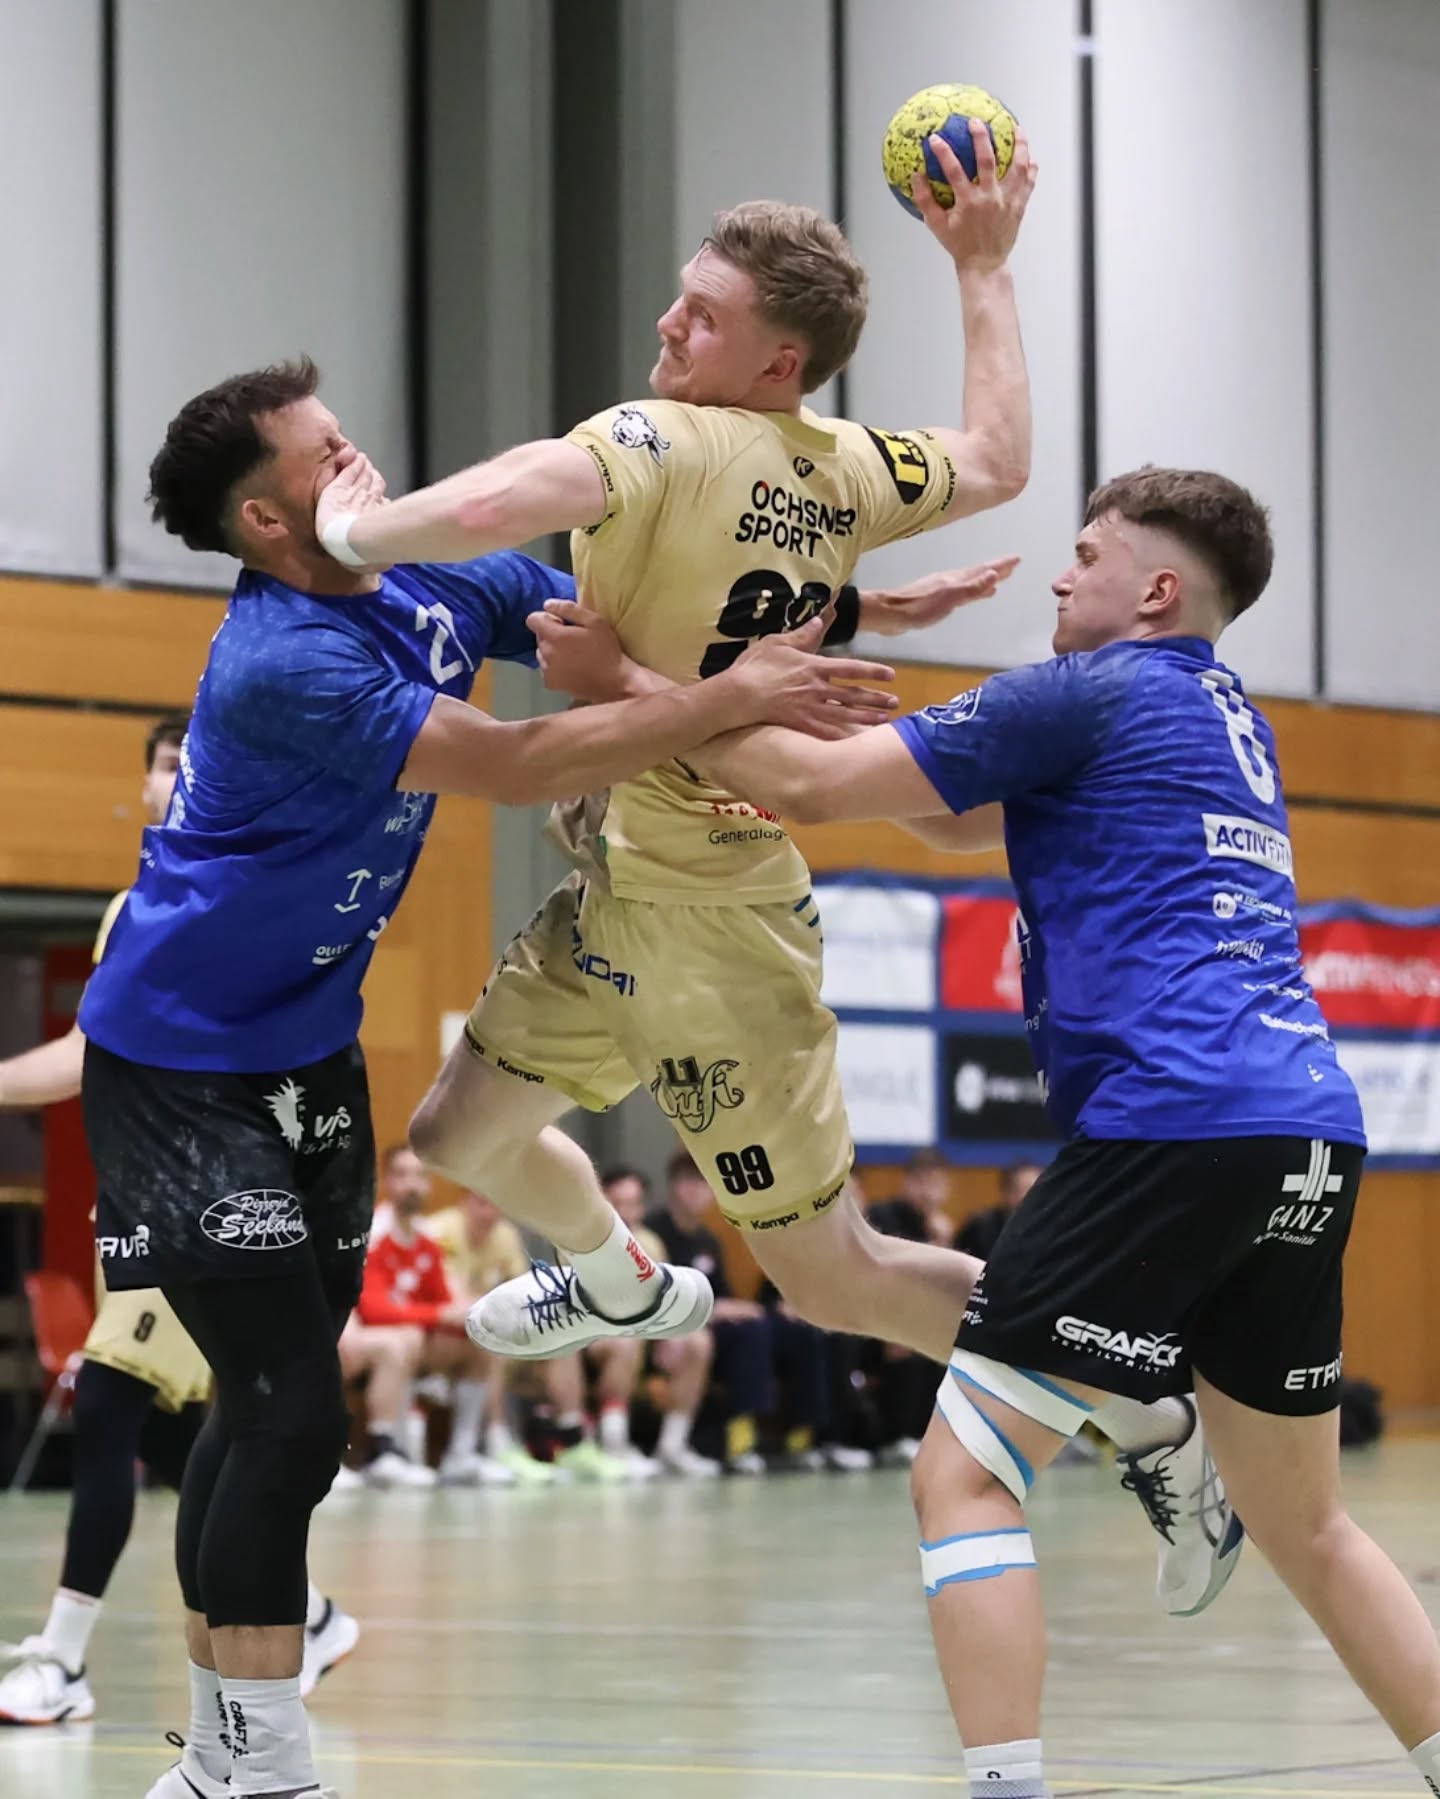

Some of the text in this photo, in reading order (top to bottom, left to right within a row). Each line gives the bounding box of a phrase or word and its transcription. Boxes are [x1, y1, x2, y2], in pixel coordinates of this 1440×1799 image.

[735, 513, 823, 558] SPORT
[708, 829, 788, 844] Generalag
[497, 1056, 545, 1084] Kempa
[715, 1144, 775, 1196] 99
[812, 1181, 846, 1211] Kemp
[750, 1211, 799, 1230] Kempa
[1266, 1204, 1335, 1232] GANZ
